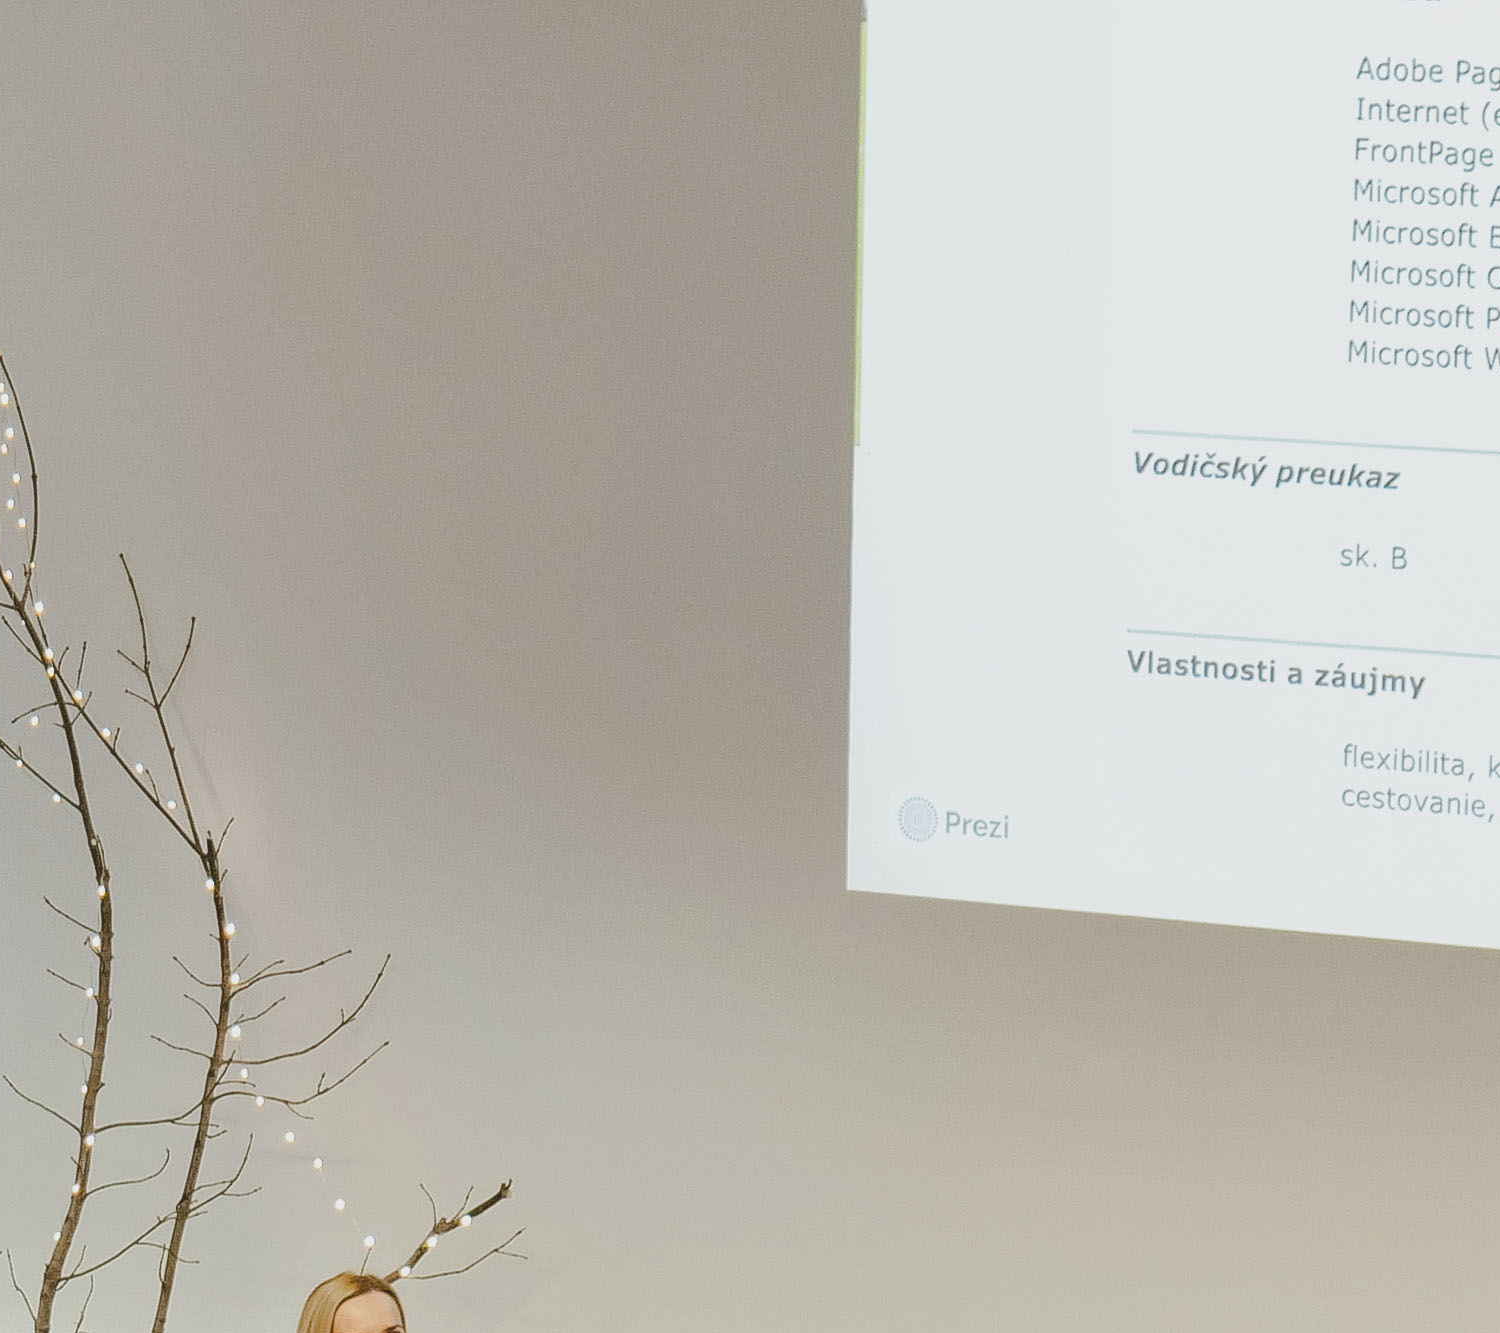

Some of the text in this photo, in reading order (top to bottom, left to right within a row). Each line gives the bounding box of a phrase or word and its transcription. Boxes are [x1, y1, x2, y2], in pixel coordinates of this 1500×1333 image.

[1356, 56, 1442, 82] Adobe
[1357, 97, 1469, 125] Internet
[1355, 137, 1492, 172] FrontPage
[1354, 178, 1478, 206] Microsoft
[1352, 219, 1476, 247] Microsoft
[1351, 259, 1475, 288] Microsoft
[1350, 300, 1474, 329] Microsoft
[1348, 340, 1472, 369] Microsoft
[1135, 451, 1400, 489] Vodičský preukaz
[1340, 544, 1406, 569] sk. B
[1127, 650, 1425, 699] Vlastnosti a záujmy
[1344, 743, 1473, 781] flexibilita,
[1342, 788, 1493, 822] cestovanie,
[946, 811, 1008, 838] Prezi
